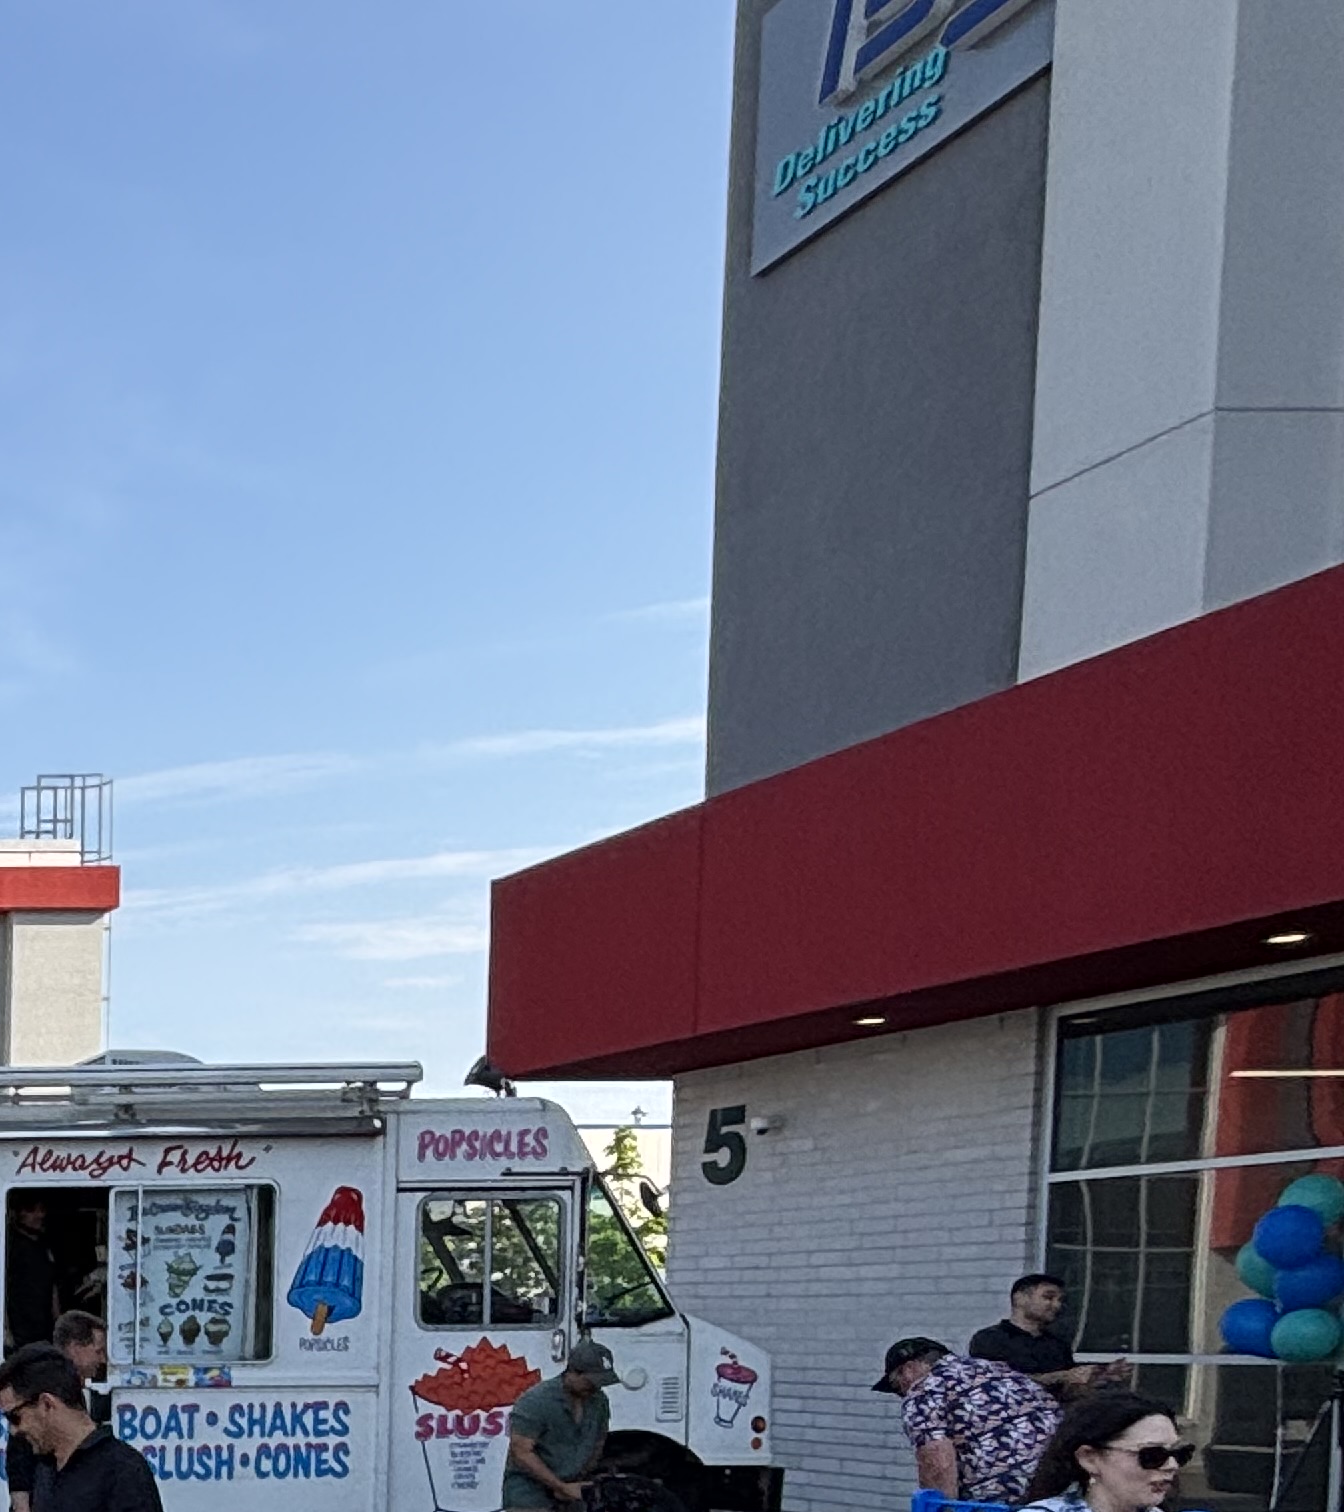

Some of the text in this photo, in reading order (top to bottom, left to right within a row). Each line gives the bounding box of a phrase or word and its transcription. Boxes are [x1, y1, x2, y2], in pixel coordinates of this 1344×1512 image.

[773, 45, 949, 195] Delivering
[793, 93, 943, 219] Success
[417, 1126, 549, 1163] POPSICLES
[701, 1104, 747, 1186] 5
[158, 1297, 234, 1316] CONES
[116, 1400, 351, 1440] BOAT SHAKES
[414, 1411, 511, 1441] SLUS
[254, 1441, 350, 1480] CONES
